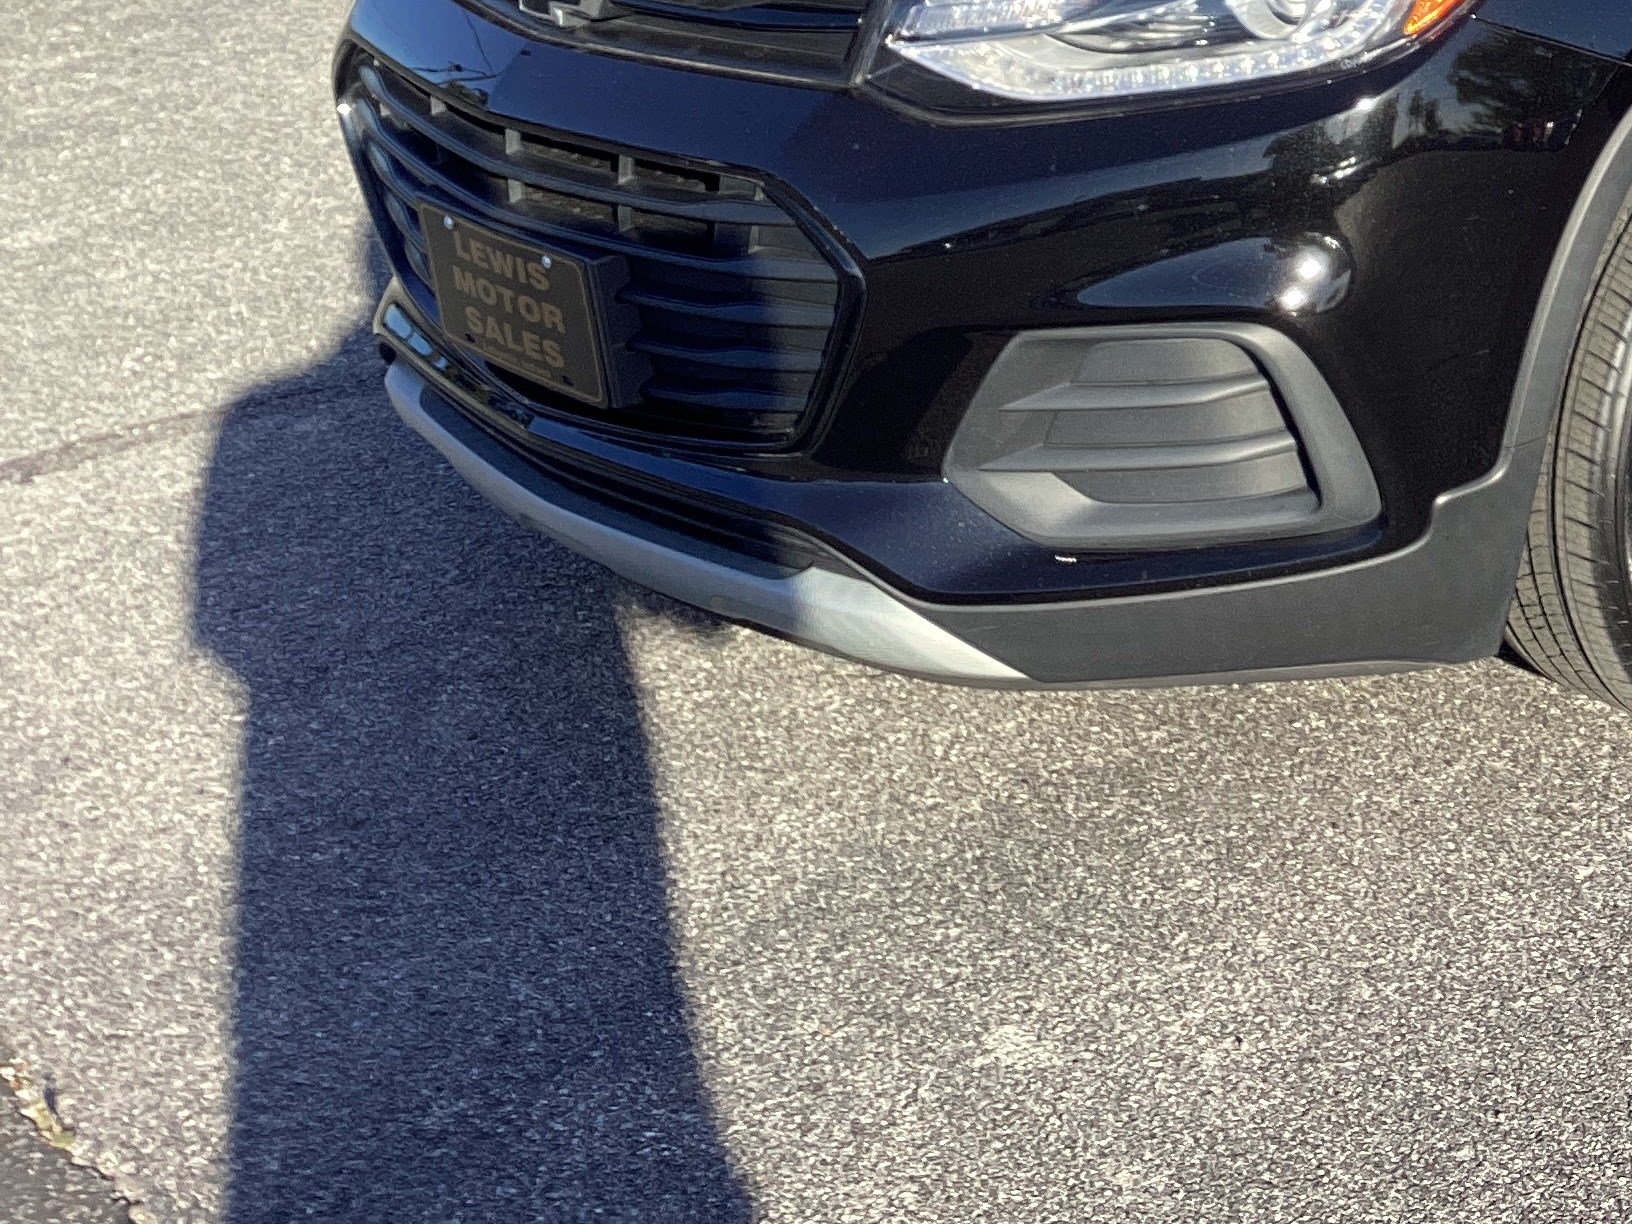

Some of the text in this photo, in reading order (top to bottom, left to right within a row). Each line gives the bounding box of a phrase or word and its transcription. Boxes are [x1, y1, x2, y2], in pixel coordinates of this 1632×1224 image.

[454, 231, 550, 291] LEWIS
[452, 265, 566, 334] MOTOR
[464, 306, 566, 368] SALES
